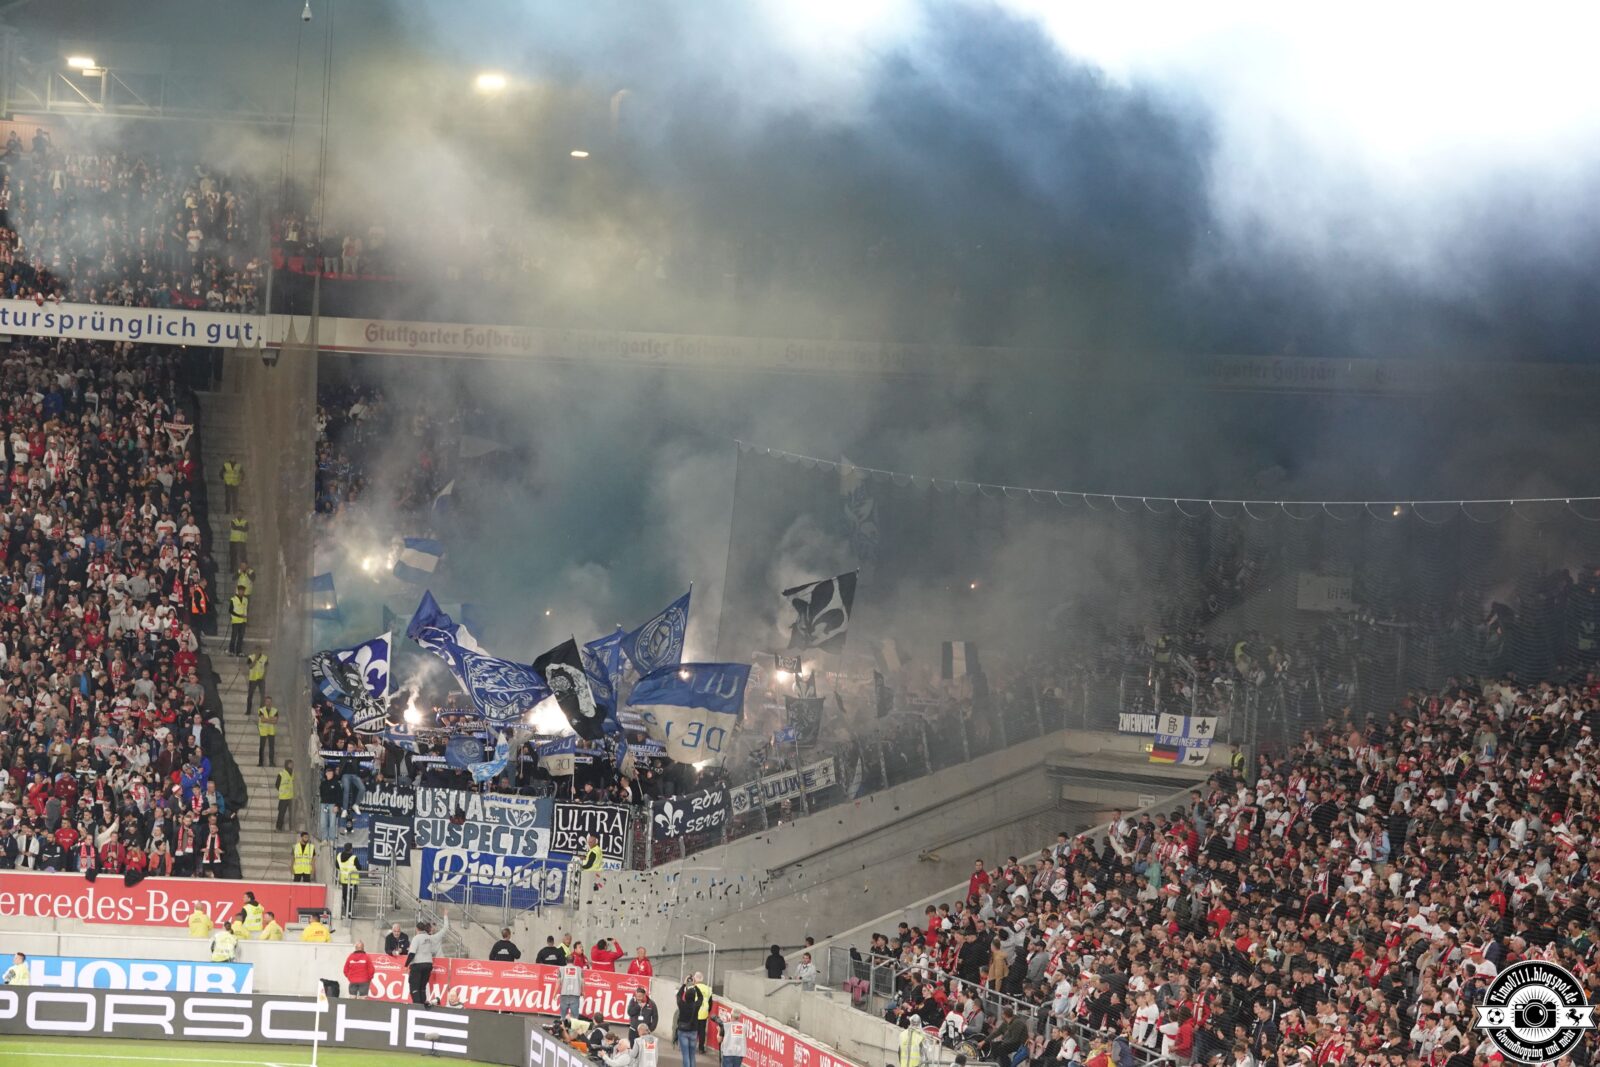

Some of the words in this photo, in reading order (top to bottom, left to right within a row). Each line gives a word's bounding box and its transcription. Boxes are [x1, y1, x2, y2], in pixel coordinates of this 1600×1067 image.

[207, 322, 262, 344] gut.
[557, 809, 623, 836] ULTRA
[416, 820, 539, 856] SUSPECTS
[600, 833, 623, 855] LIS
[0, 990, 469, 1054] ORSCHE
